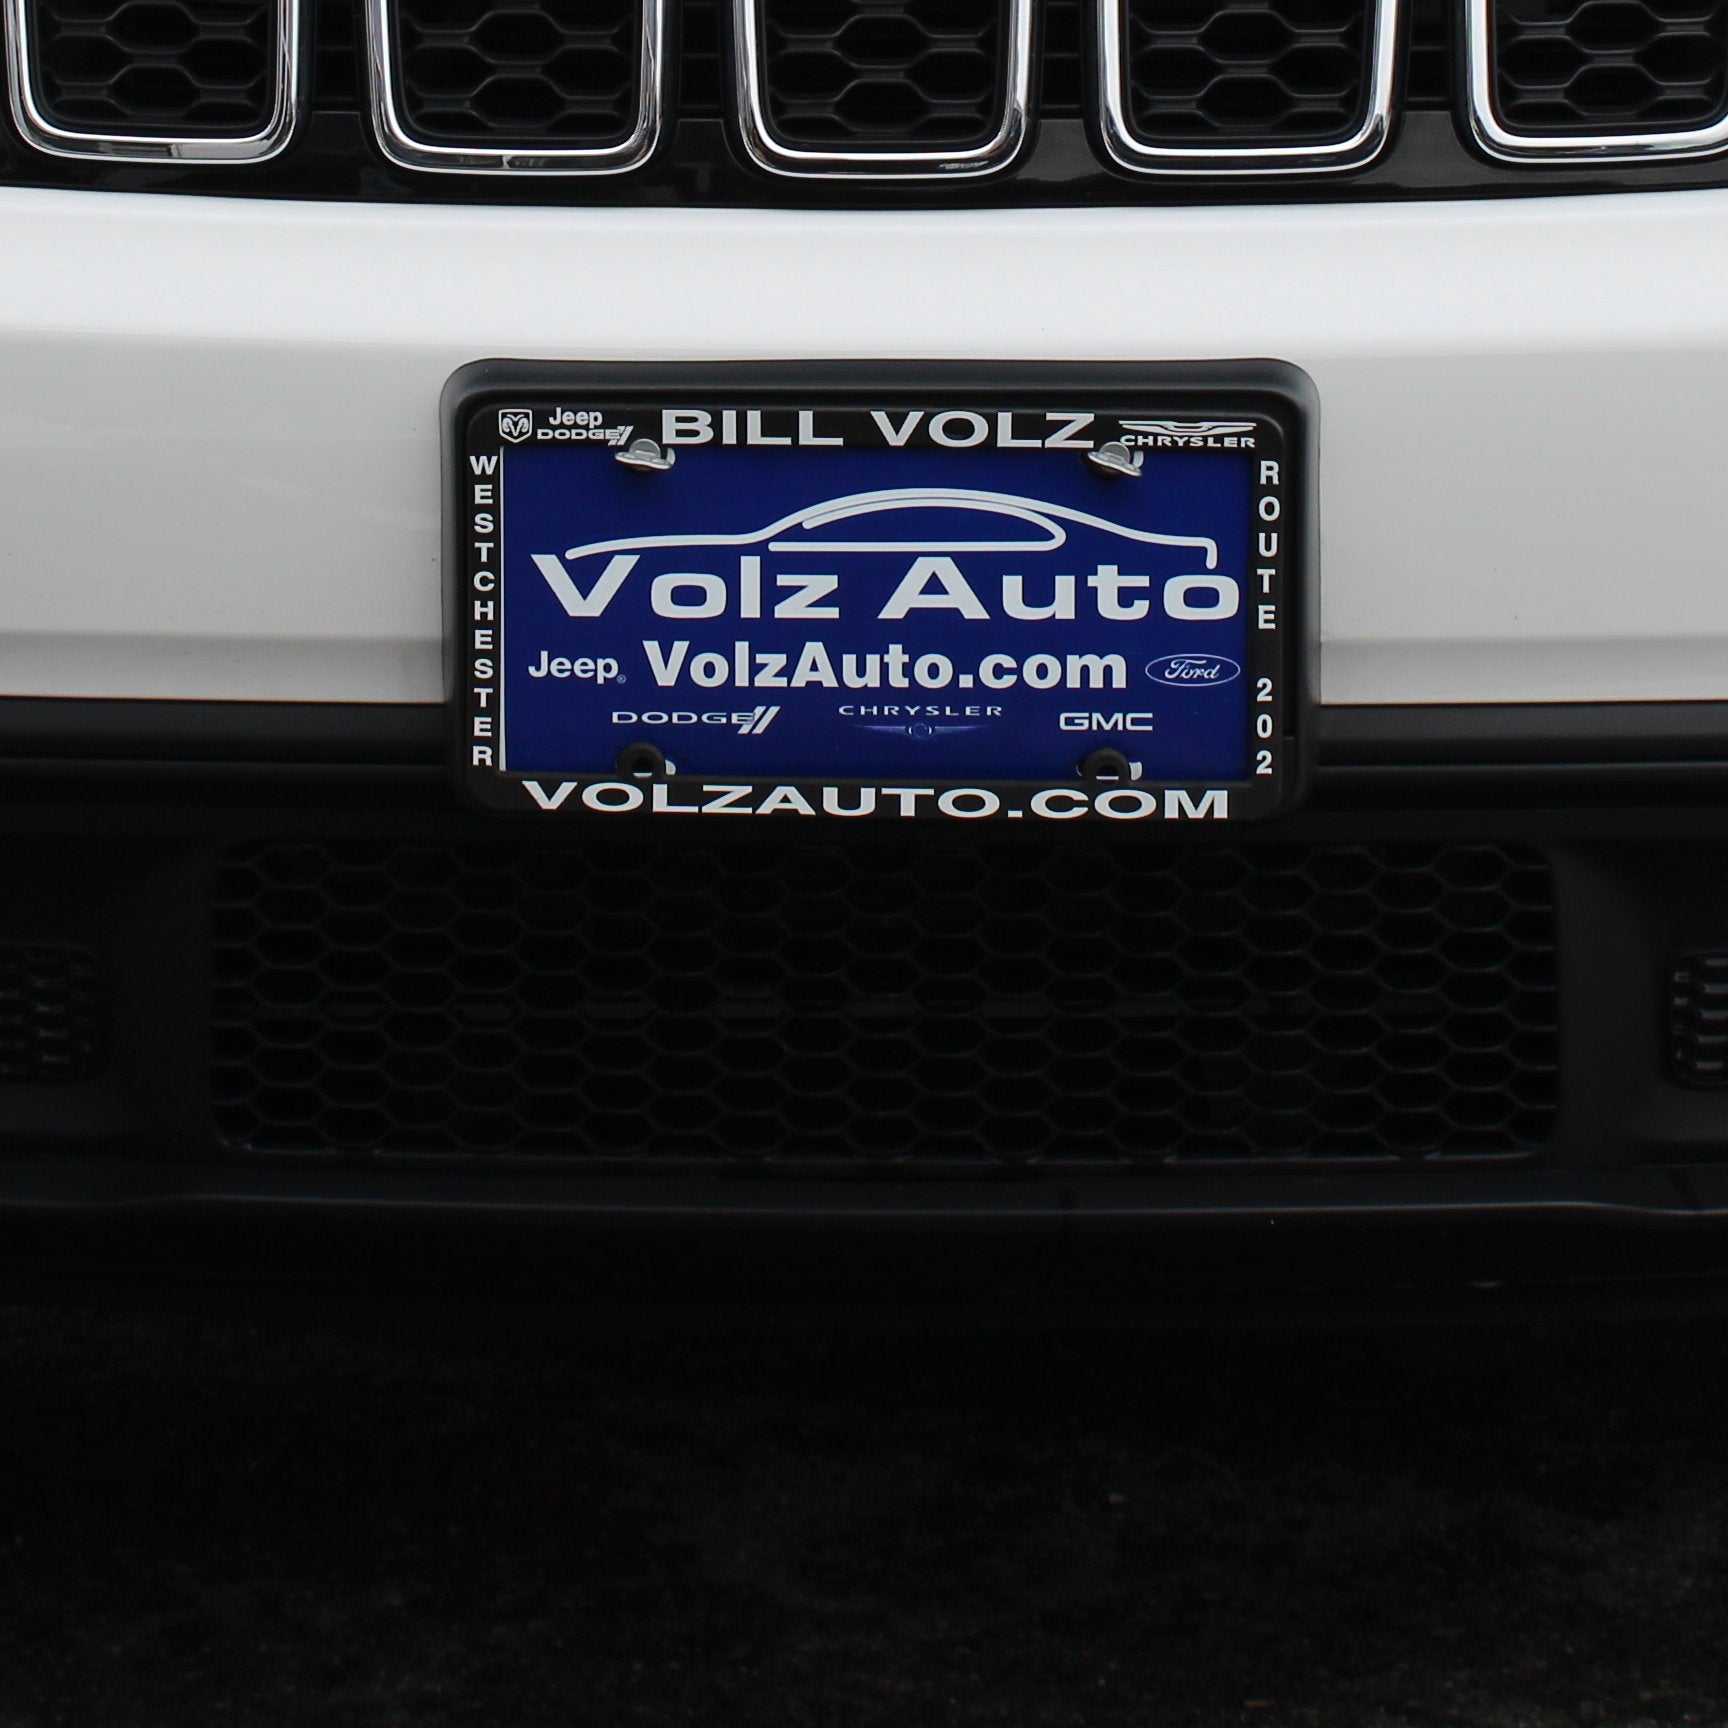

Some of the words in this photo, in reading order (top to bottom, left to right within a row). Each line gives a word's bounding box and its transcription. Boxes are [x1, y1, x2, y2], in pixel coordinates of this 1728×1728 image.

[536, 428, 622, 440] DODGE
[548, 407, 603, 429] Jeep
[661, 409, 843, 446] BILL
[870, 411, 1095, 449] VOLZ
[1120, 435, 1256, 448] CHRYSLER
[1256, 460, 1281, 631] ROUTE
[531, 554, 840, 619] Volz
[877, 556, 1241, 622] Auto
[469, 455, 498, 767] WESTCHESTER
[528, 650, 618, 684] Jeep
[642, 640, 1127, 689] VolzAuto.com
[1163, 658, 1221, 680] Ford
[612, 710, 756, 724] DODGE
[838, 705, 1003, 716] CHRYSLER
[1059, 712, 1154, 732] GMC
[1255, 677, 1273, 775] 202
[522, 780, 1229, 818] VOLZAUTO.COM
